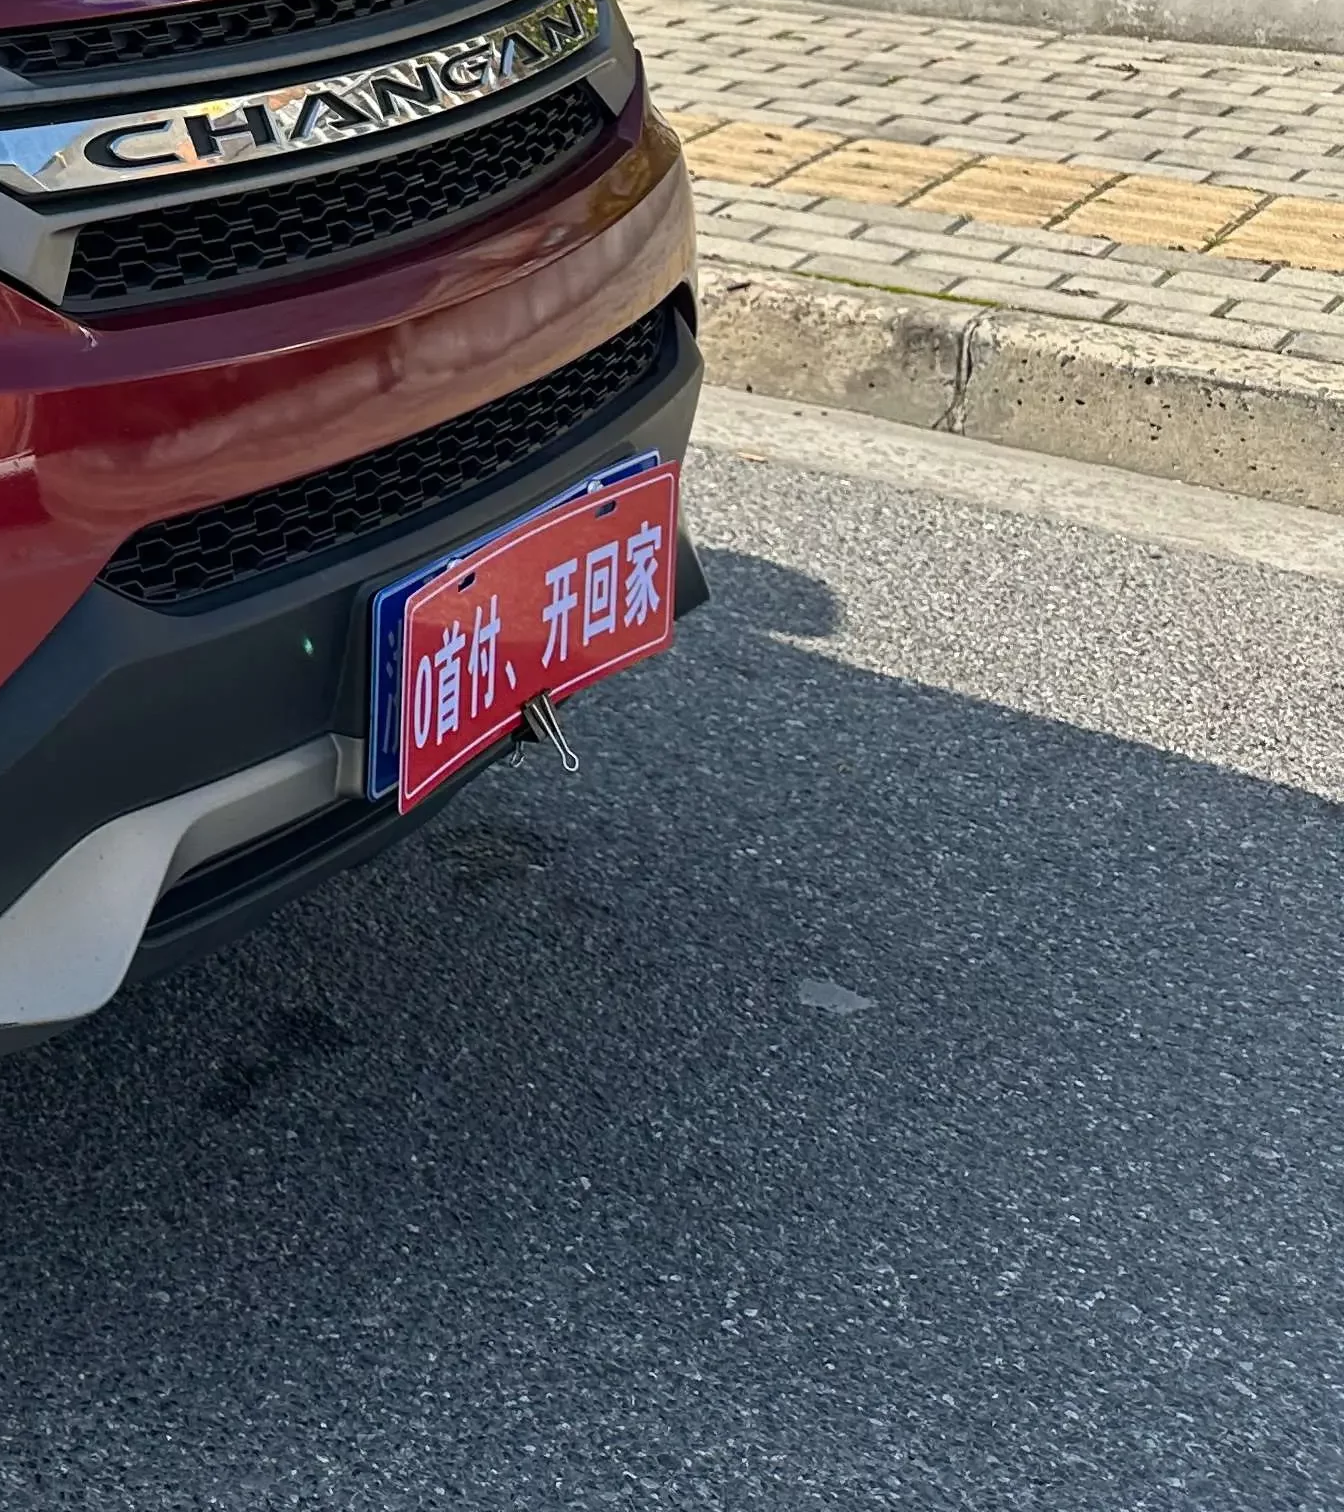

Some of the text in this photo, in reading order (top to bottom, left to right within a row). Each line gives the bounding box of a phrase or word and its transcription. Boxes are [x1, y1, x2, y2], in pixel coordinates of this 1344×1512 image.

[83, 2, 588, 169] CHANGAN
[413, 520, 662, 749] 0首付、开回家
